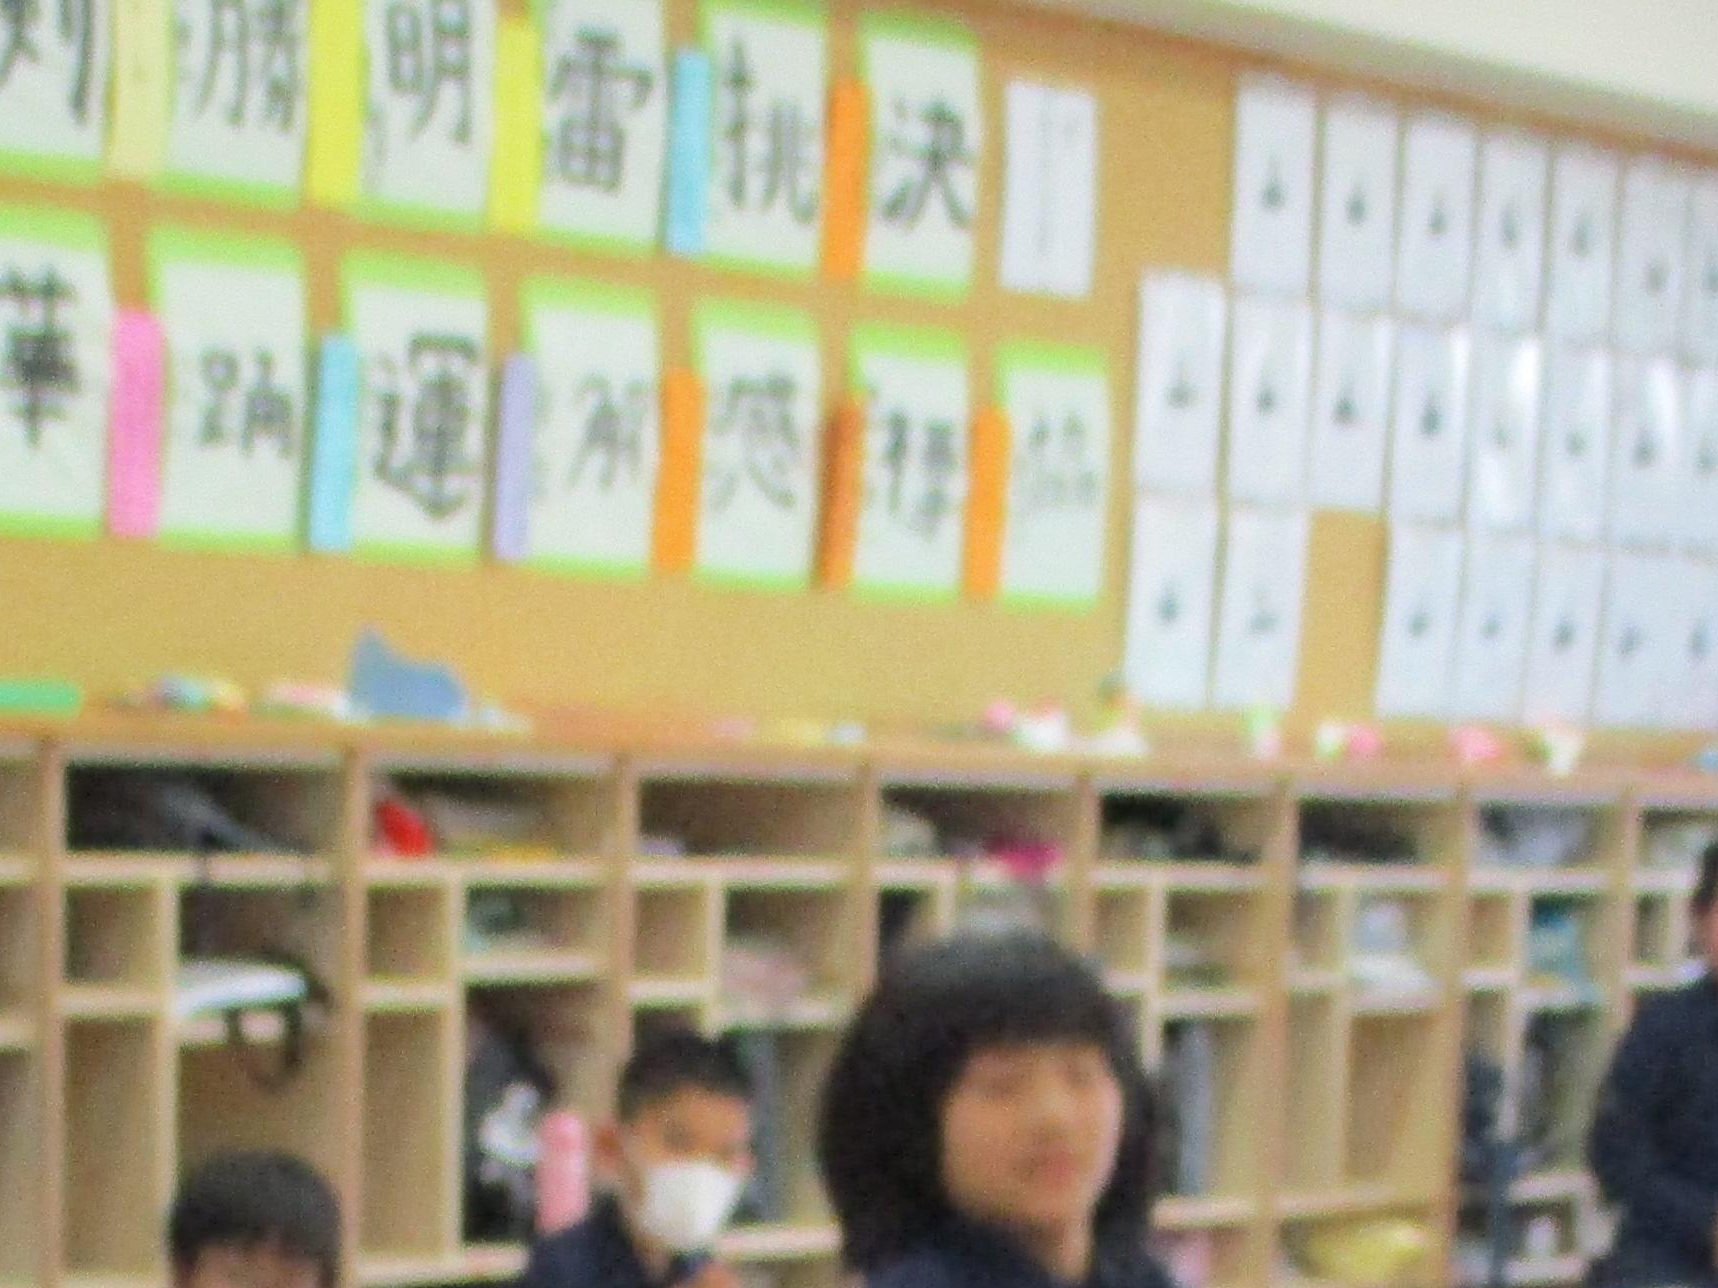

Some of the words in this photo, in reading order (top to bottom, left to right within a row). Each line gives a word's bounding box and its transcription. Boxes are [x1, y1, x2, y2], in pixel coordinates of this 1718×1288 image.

[383, 0, 473, 144] 明
[548, 26, 656, 195] 雷
[881, 98, 975, 230] 決
[373, 332, 481, 520] 運
